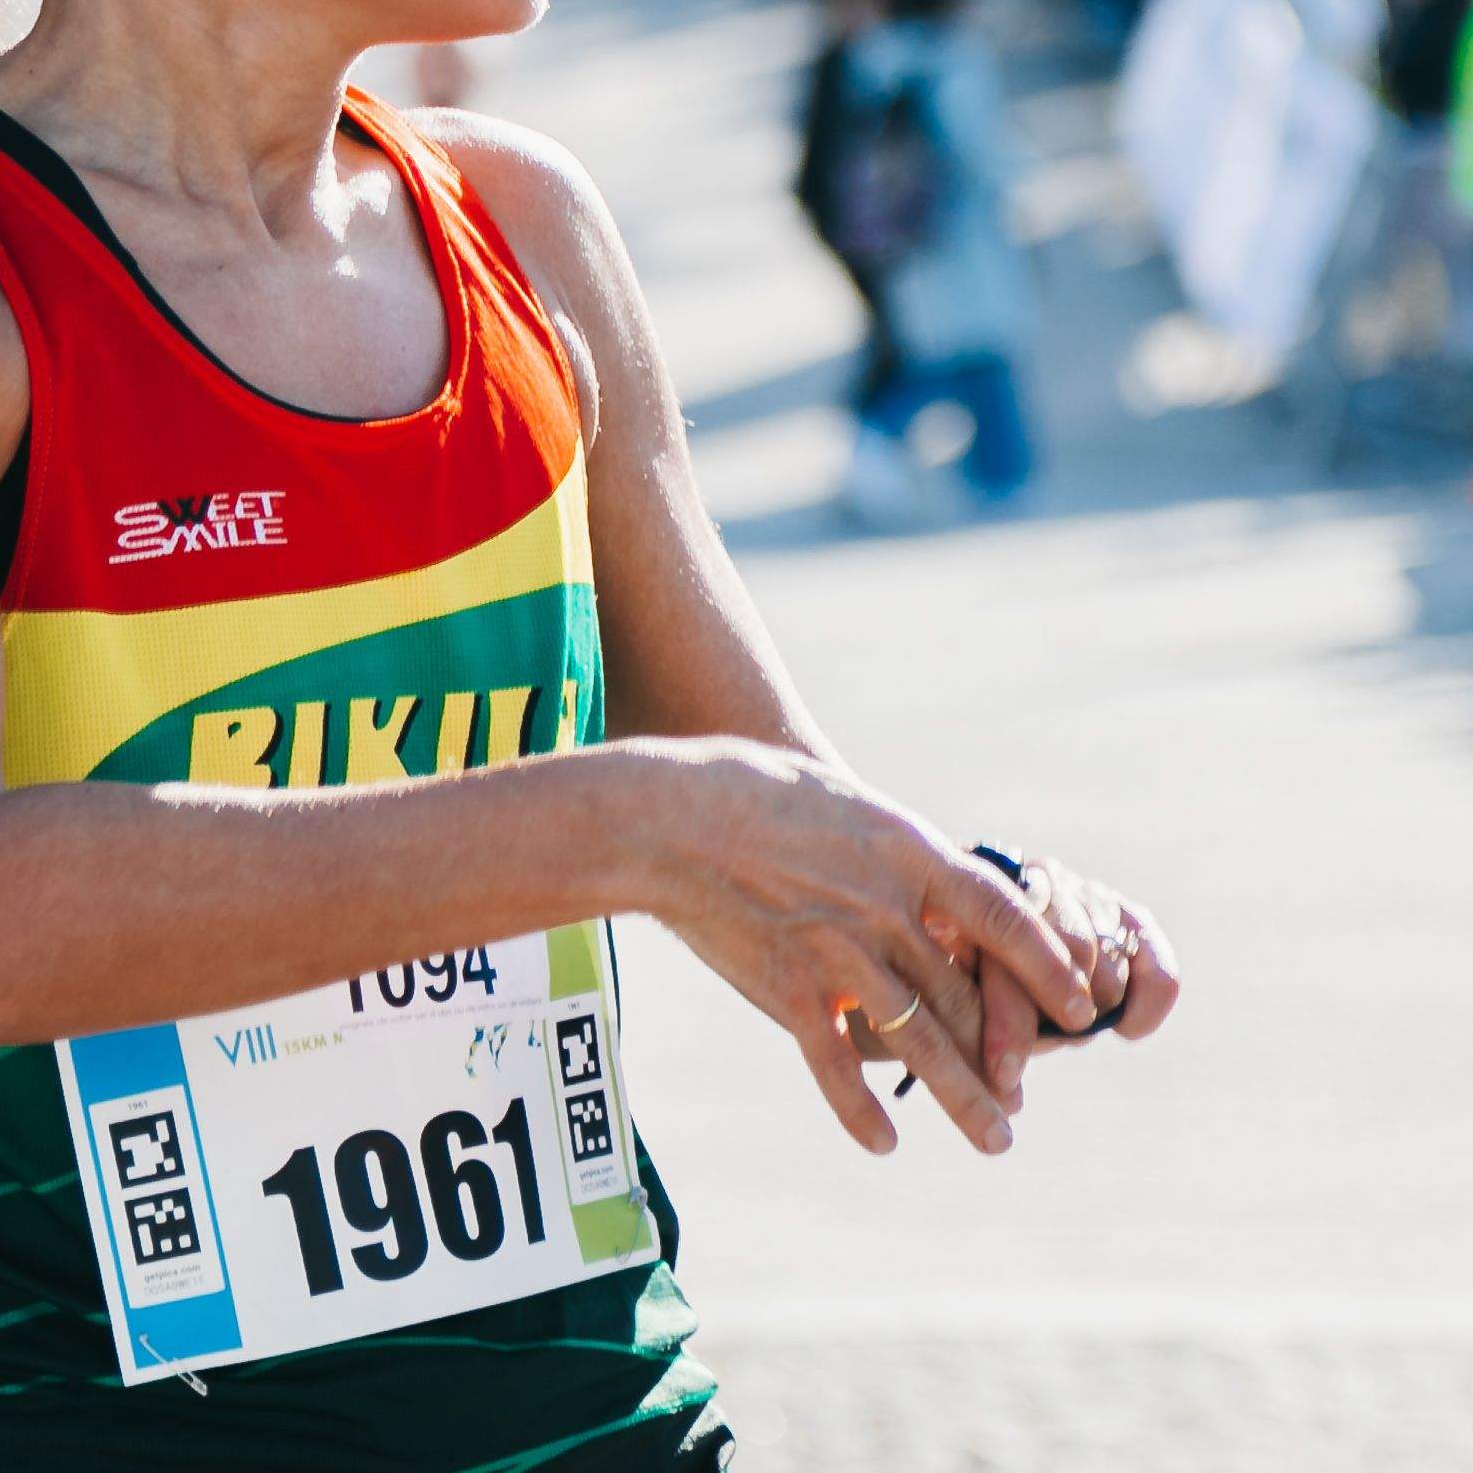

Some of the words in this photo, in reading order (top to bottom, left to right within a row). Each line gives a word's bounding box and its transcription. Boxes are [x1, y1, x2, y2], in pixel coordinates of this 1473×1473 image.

[114, 491, 286, 530] SWEET
[109, 518, 288, 565] SMILE
[214, 1023, 277, 1068] VIII
[262, 1097, 546, 1296] 1961
